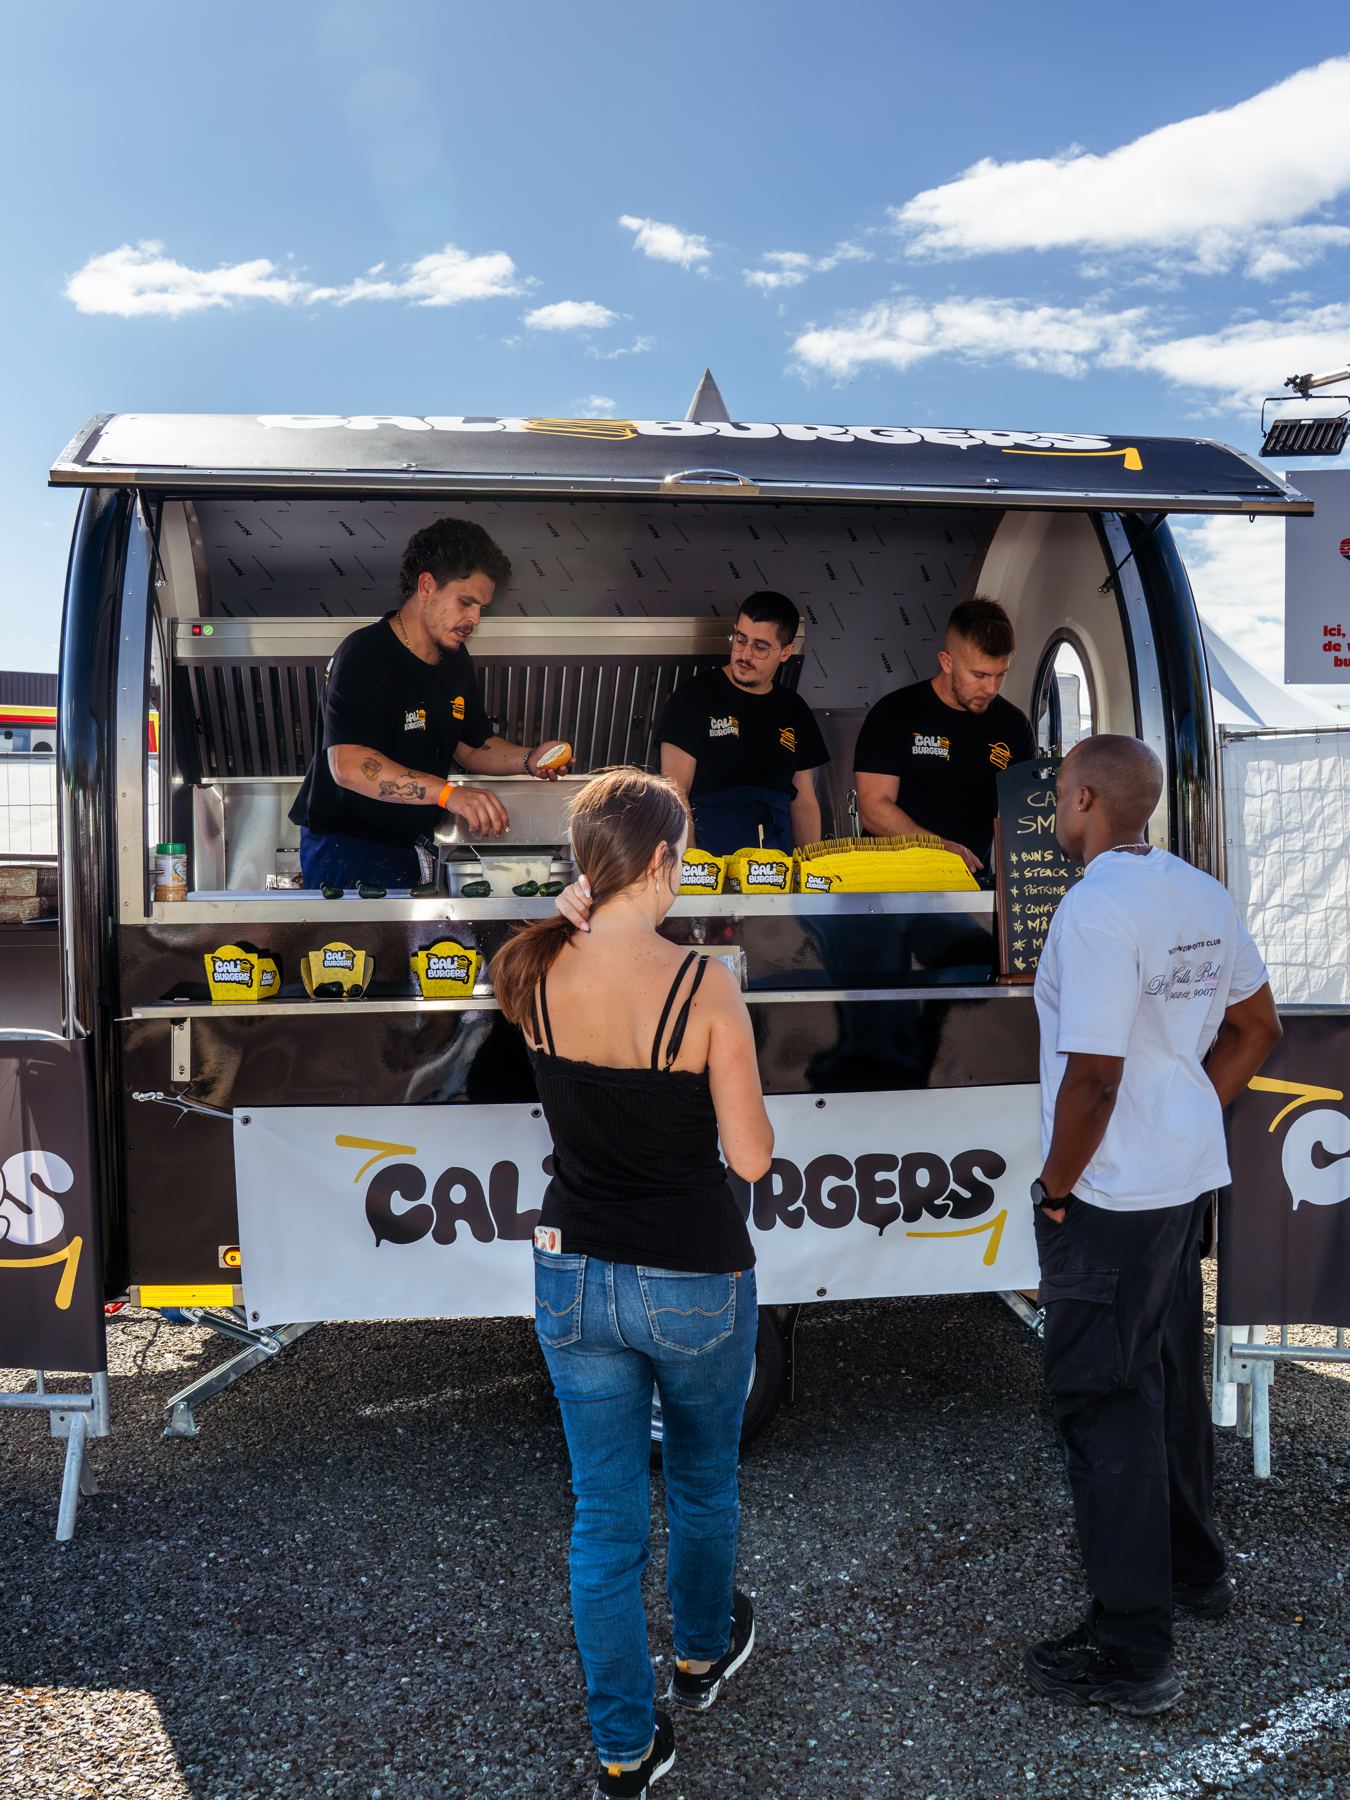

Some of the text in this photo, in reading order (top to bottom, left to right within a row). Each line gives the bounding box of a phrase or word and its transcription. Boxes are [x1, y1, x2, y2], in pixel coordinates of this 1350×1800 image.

[638, 420, 1111, 449] BURGERS
[1323, 624, 1346, 638] Ici,
[1323, 640, 1342, 652] de
[881, 653, 893, 673] Nitto
[912, 746, 949, 756] BURGERS
[1027, 791, 1056, 807] CA
[1016, 813, 1056, 835] SM
[1023, 867, 1069, 879] STEACK
[748, 875, 785, 884] BURGERS
[1206, 939, 1221, 947] CLUB
[213, 972, 251, 983] BURGERS
[427, 968, 467, 978] BURGERS
[365, 1149, 1006, 1247] CAL RGERS
